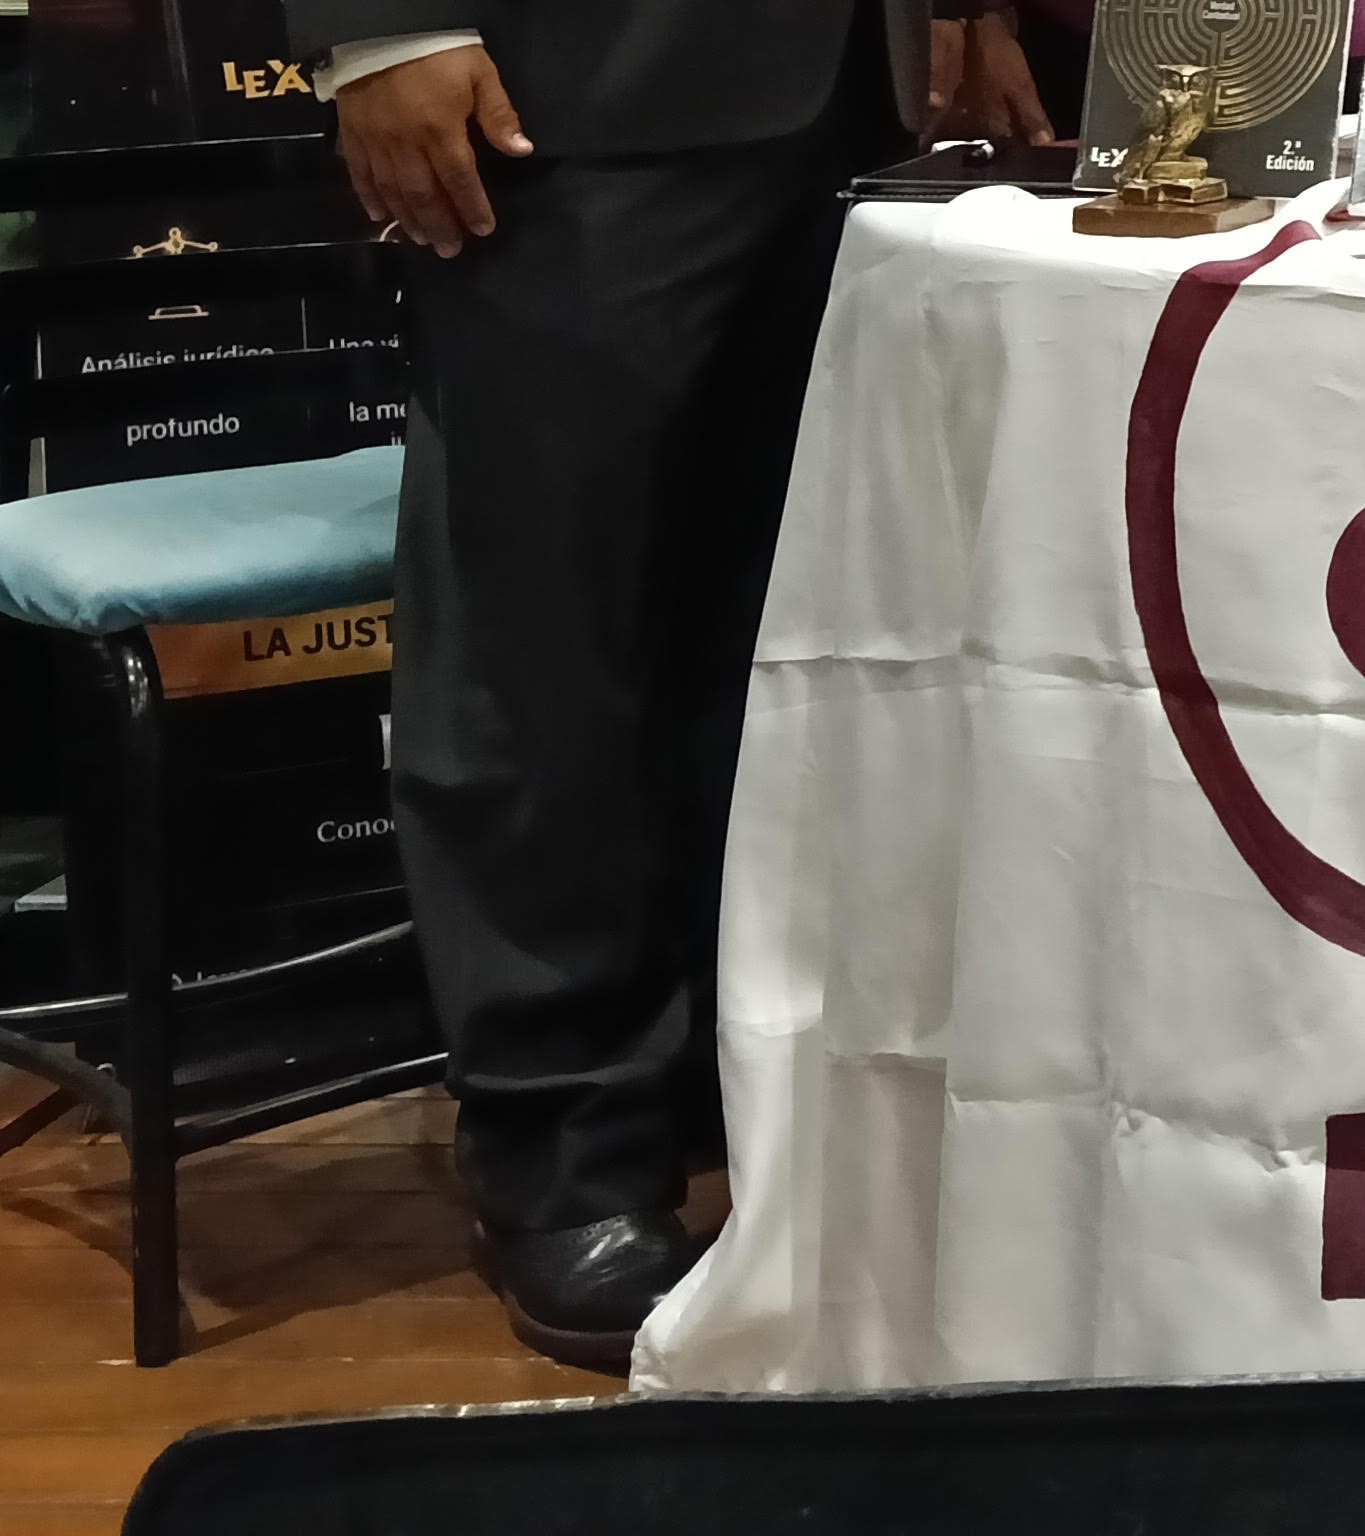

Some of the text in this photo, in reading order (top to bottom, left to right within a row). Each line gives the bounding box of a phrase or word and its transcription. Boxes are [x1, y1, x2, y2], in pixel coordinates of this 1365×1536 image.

[1091, 147, 1129, 168] LEX
[1266, 155, 1314, 171] Edición
[349, 401, 370, 423] la
[126, 414, 240, 447] profundo
[243, 616, 393, 661] LA JUST
